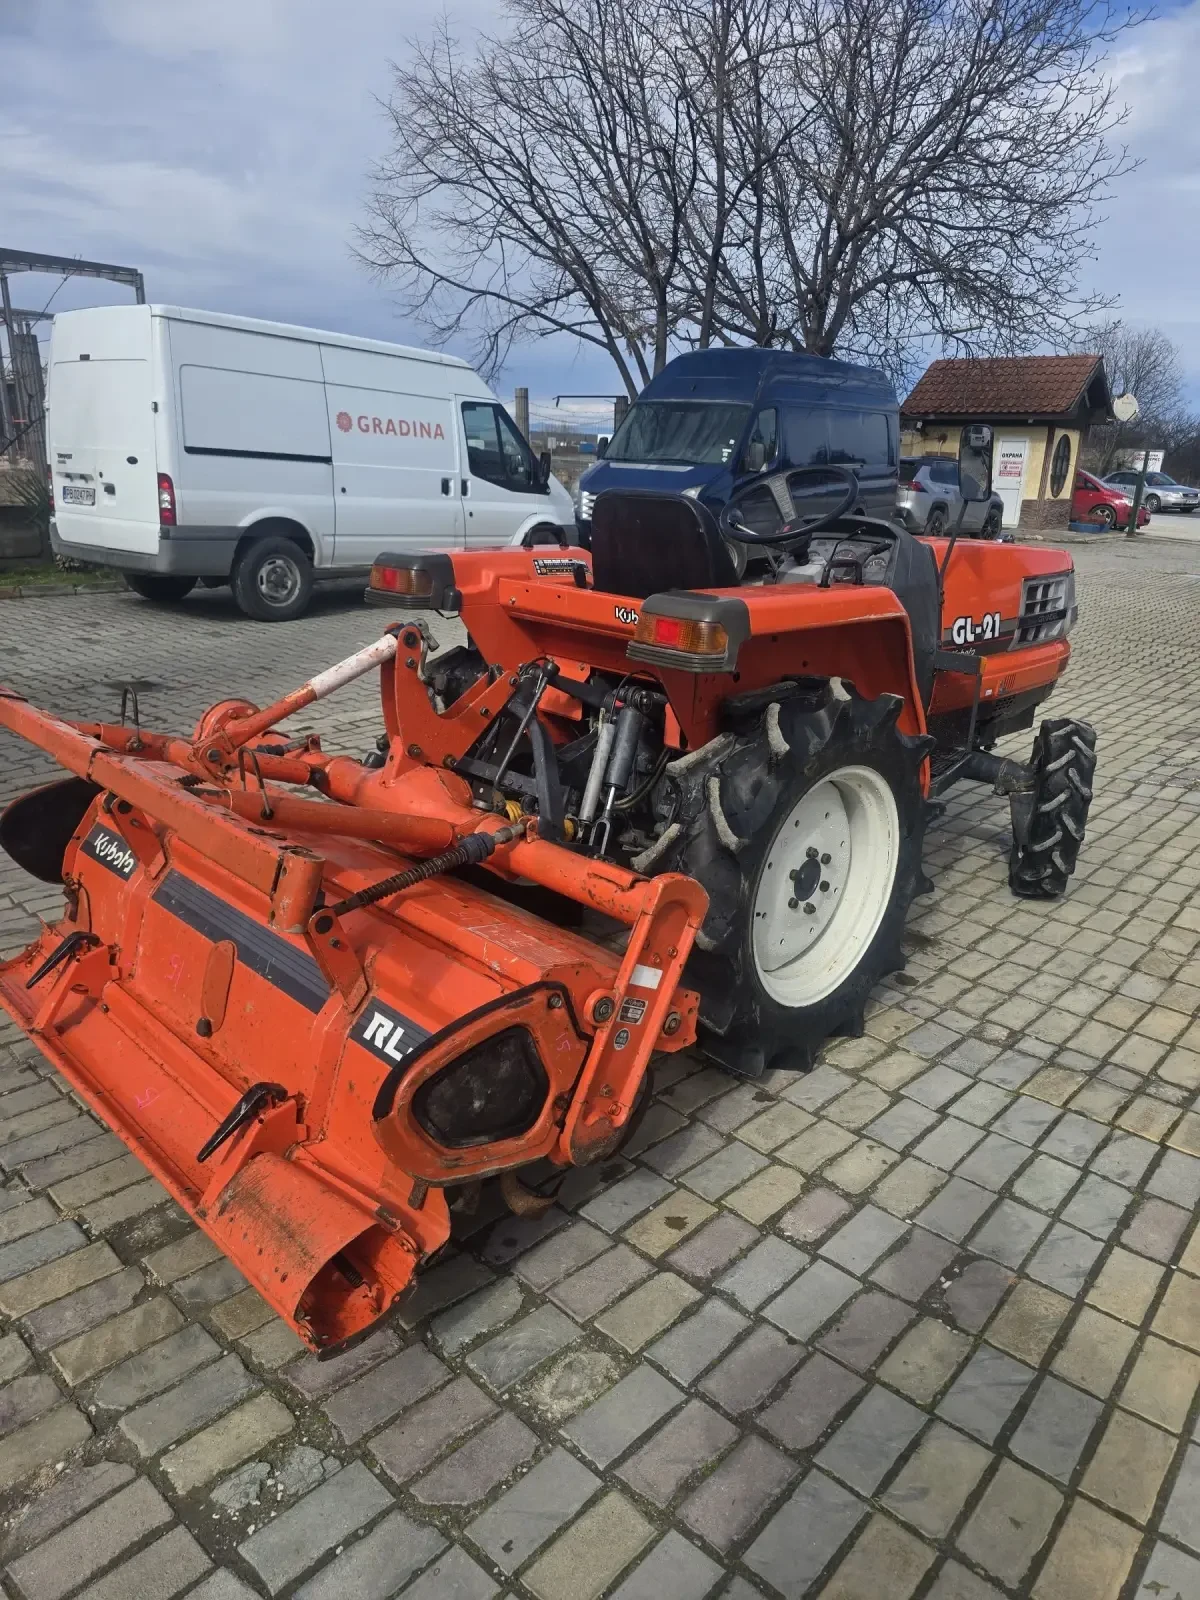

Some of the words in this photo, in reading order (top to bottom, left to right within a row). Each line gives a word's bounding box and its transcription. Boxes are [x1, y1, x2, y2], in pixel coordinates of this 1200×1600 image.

[357, 415, 445, 440] GRADINA
[615, 606, 639, 625] Kub
[952, 612, 1001, 645] GL-21
[94, 832, 135, 873] Kubota
[362, 1011, 413, 1062] RL
